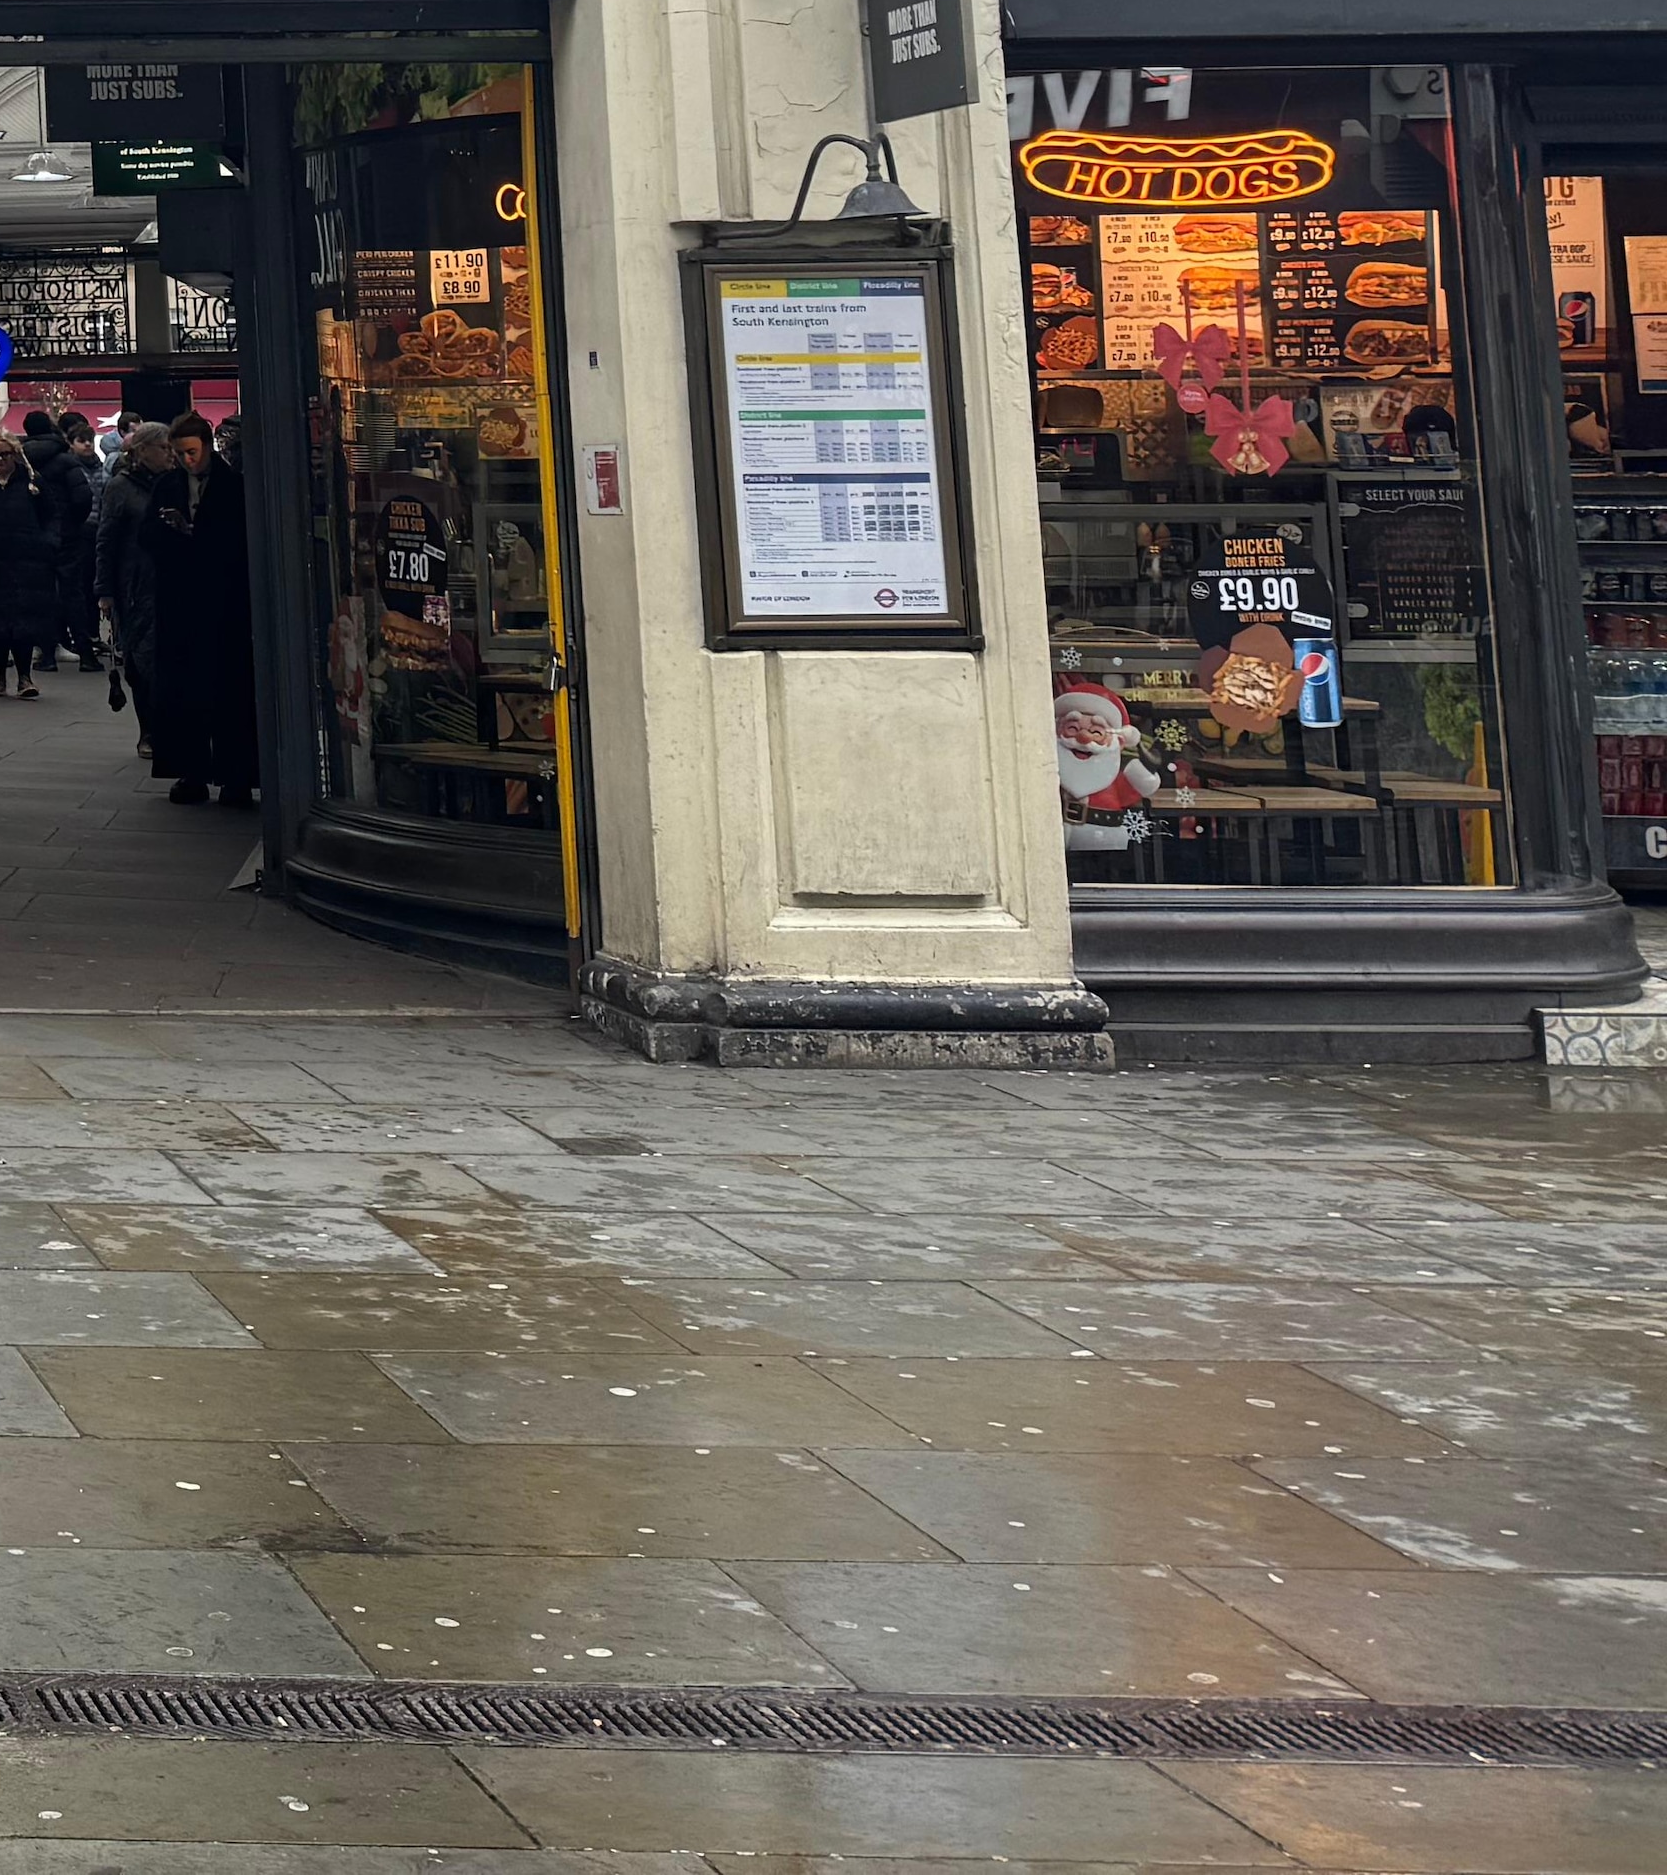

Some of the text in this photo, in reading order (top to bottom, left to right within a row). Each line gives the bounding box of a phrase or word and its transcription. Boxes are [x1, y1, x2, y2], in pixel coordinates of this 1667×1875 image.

[888, 5, 913, 35] MORE
[892, 28, 941, 64] JUST SUBS.
[90, 79, 184, 101] JUST SUBS.
[1065, 161, 1301, 200] HOT DOGS
[434, 253, 483, 270] £11.90
[443, 280, 481, 295] £8.90
[730, 283, 753, 291] Circle
[863, 281, 902, 291] Piccadilly
[732, 303, 867, 313] First and last trains from
[732, 317, 829, 328] South Kensington
[1366, 489, 1436, 501] SELECT YOUR
[1224, 538, 1284, 555] CHICKEN
[389, 550, 429, 582] £7.80
[1225, 556, 1286, 568] DONER FRIES
[1218, 577, 1299, 611] £9.90
[1238, 612, 1259, 623] WITH
[1143, 669, 1193, 685] MERRY
